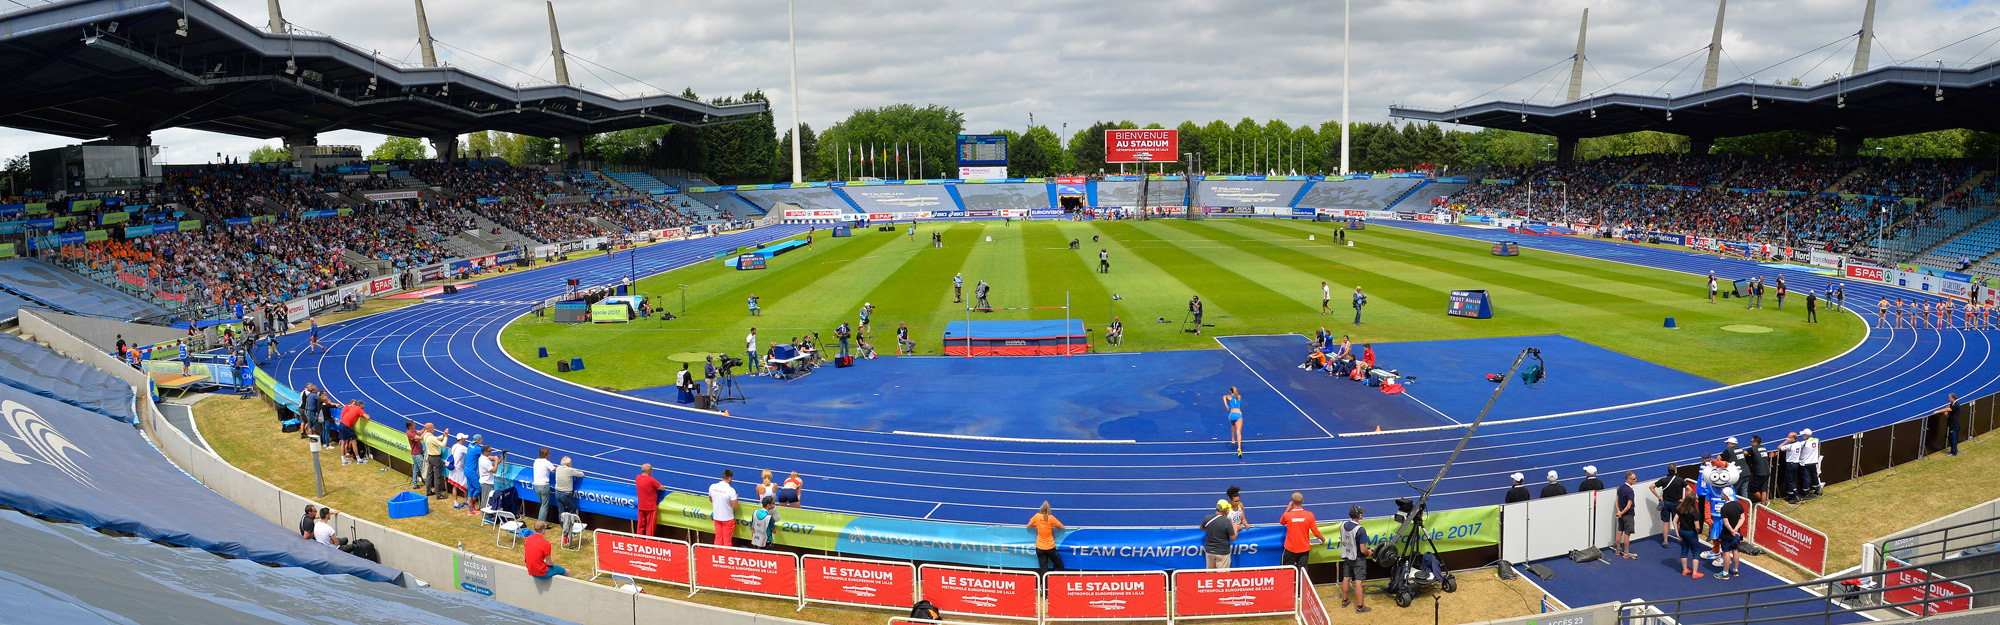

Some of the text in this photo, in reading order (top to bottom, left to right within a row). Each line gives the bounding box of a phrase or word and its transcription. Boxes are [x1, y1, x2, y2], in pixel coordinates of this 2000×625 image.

[1116, 132, 1168, 140] BIENVENUE
[1795, 250, 1810, 260] Nord
[1855, 268, 1882, 279] SPAR
[375, 278, 392, 291] SPAR
[309, 290, 339, 311] Nord Nord
[844, 356, 853, 365] 31
[683, 508, 706, 520] Lille
[782, 522, 815, 535] 2017
[1447, 522, 1482, 539] 2017
[1767, 518, 1812, 545] LE STADIUM
[612, 541, 671, 557] LE STADIUM
[870, 533, 1036, 555] EUROPEAN ATHLETIC
[1070, 546, 1117, 557] TEAM
[464, 560, 480, 570] ACCÈS
[712, 555, 777, 569] LE STADIUM
[464, 568, 476, 576] RANG
[823, 566, 893, 580] LE STADIUM
[1900, 572, 1911, 583] LE
[941, 576, 1015, 590] LE STADIUM
[1067, 582, 1144, 591] LE STADIUM
[1197, 577, 1274, 588] LE STADIUM
